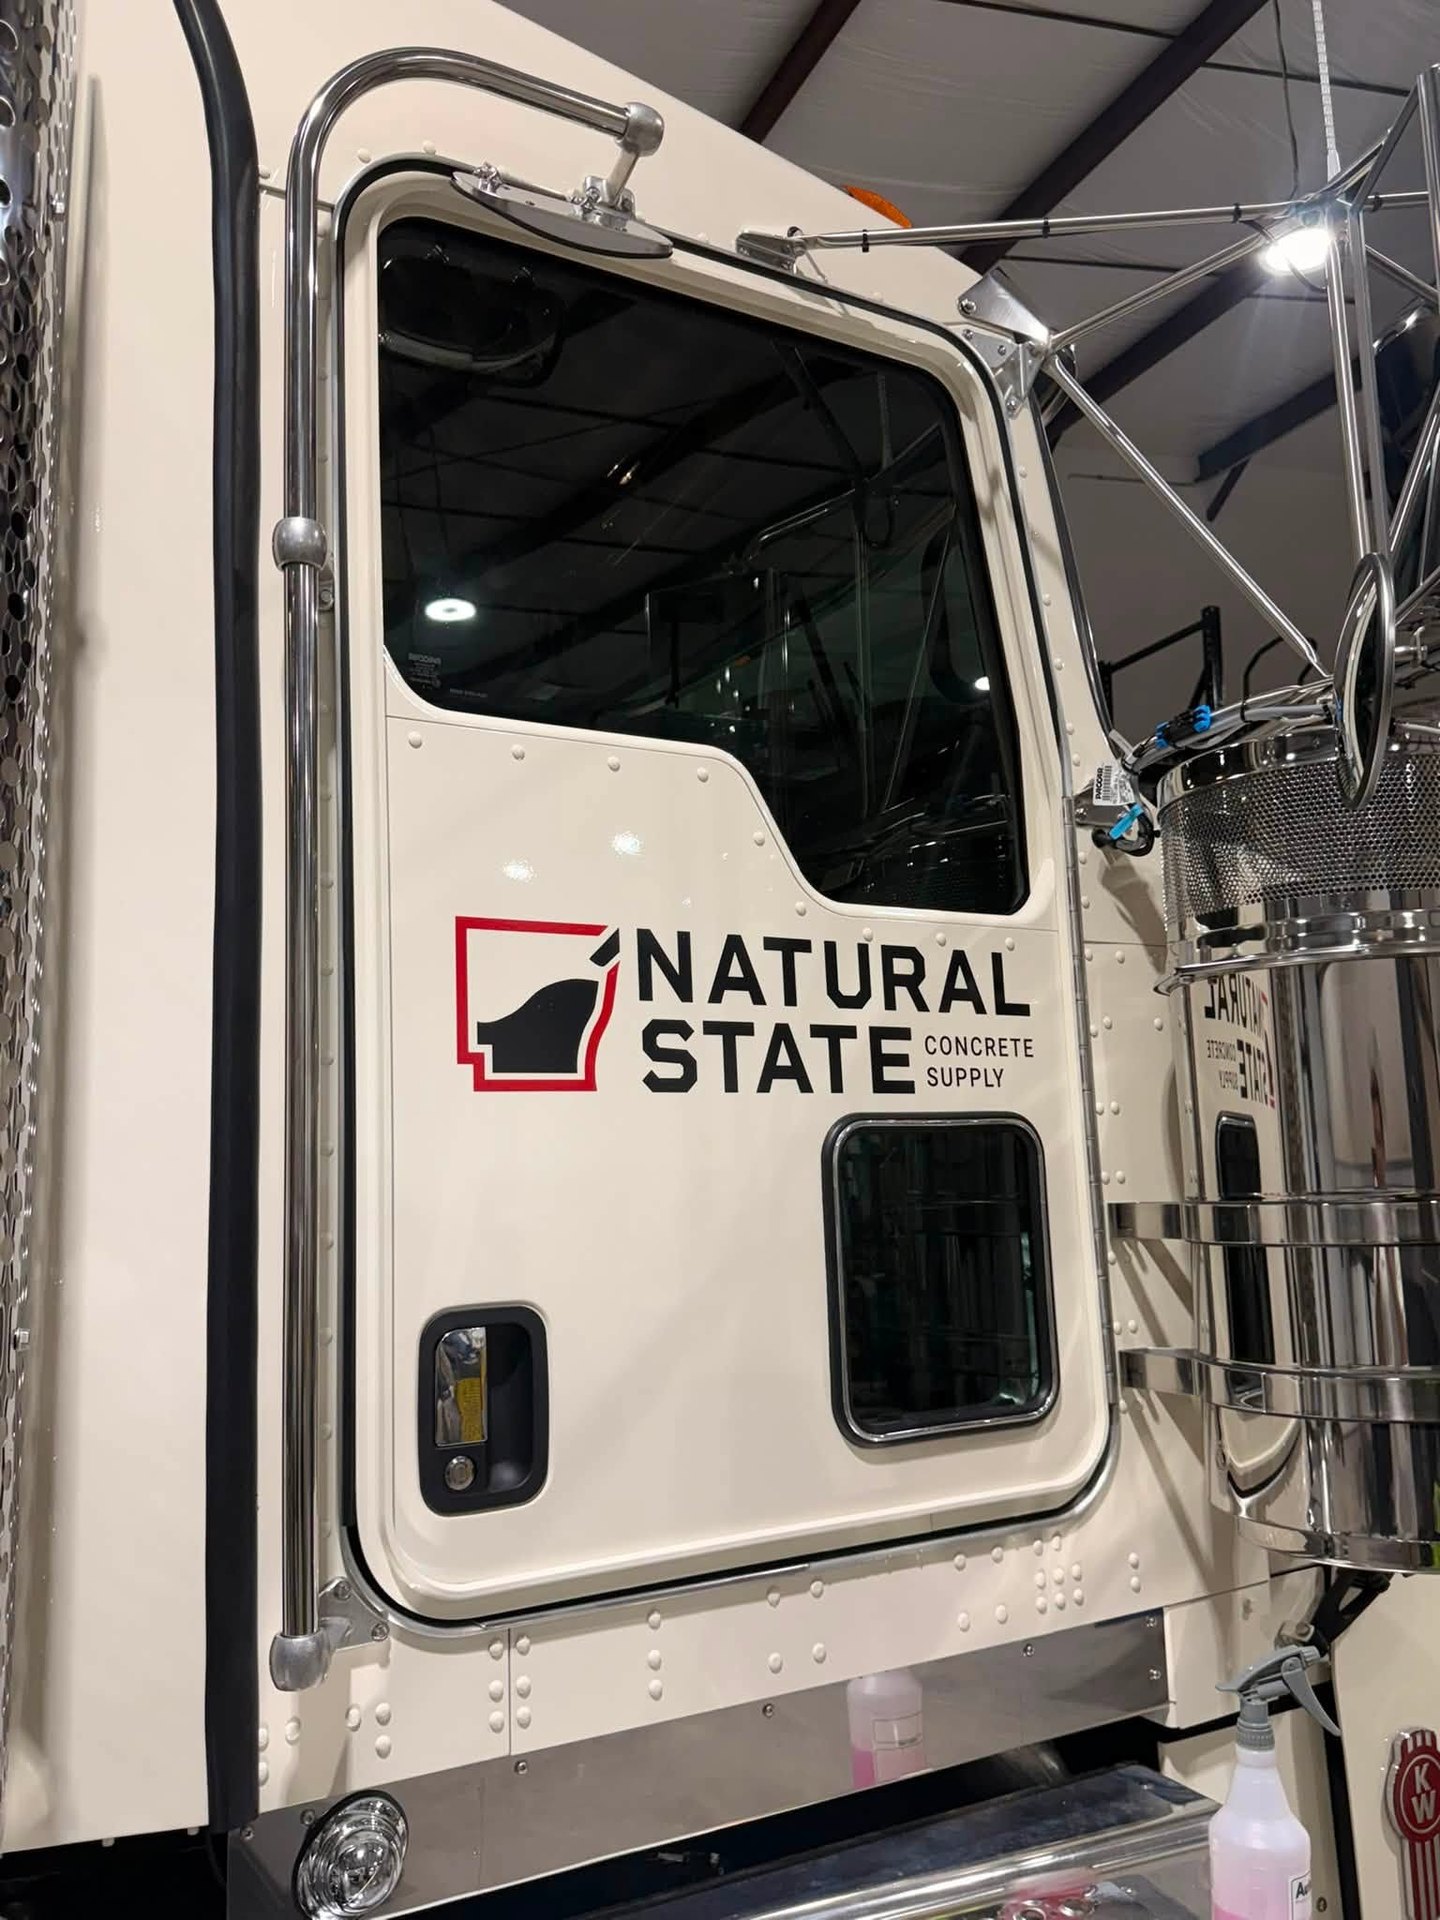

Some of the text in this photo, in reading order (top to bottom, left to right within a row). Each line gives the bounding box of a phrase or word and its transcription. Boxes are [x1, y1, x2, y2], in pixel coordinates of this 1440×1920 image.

[636, 928, 1031, 1017] NATURAL
[642, 1019, 916, 1094] STATE
[924, 1034, 1035, 1058] CONCRETE
[926, 1067, 1005, 1088] SUPPLY
[1414, 1763, 1431, 1794] K
[1411, 1790, 1437, 1824] W
